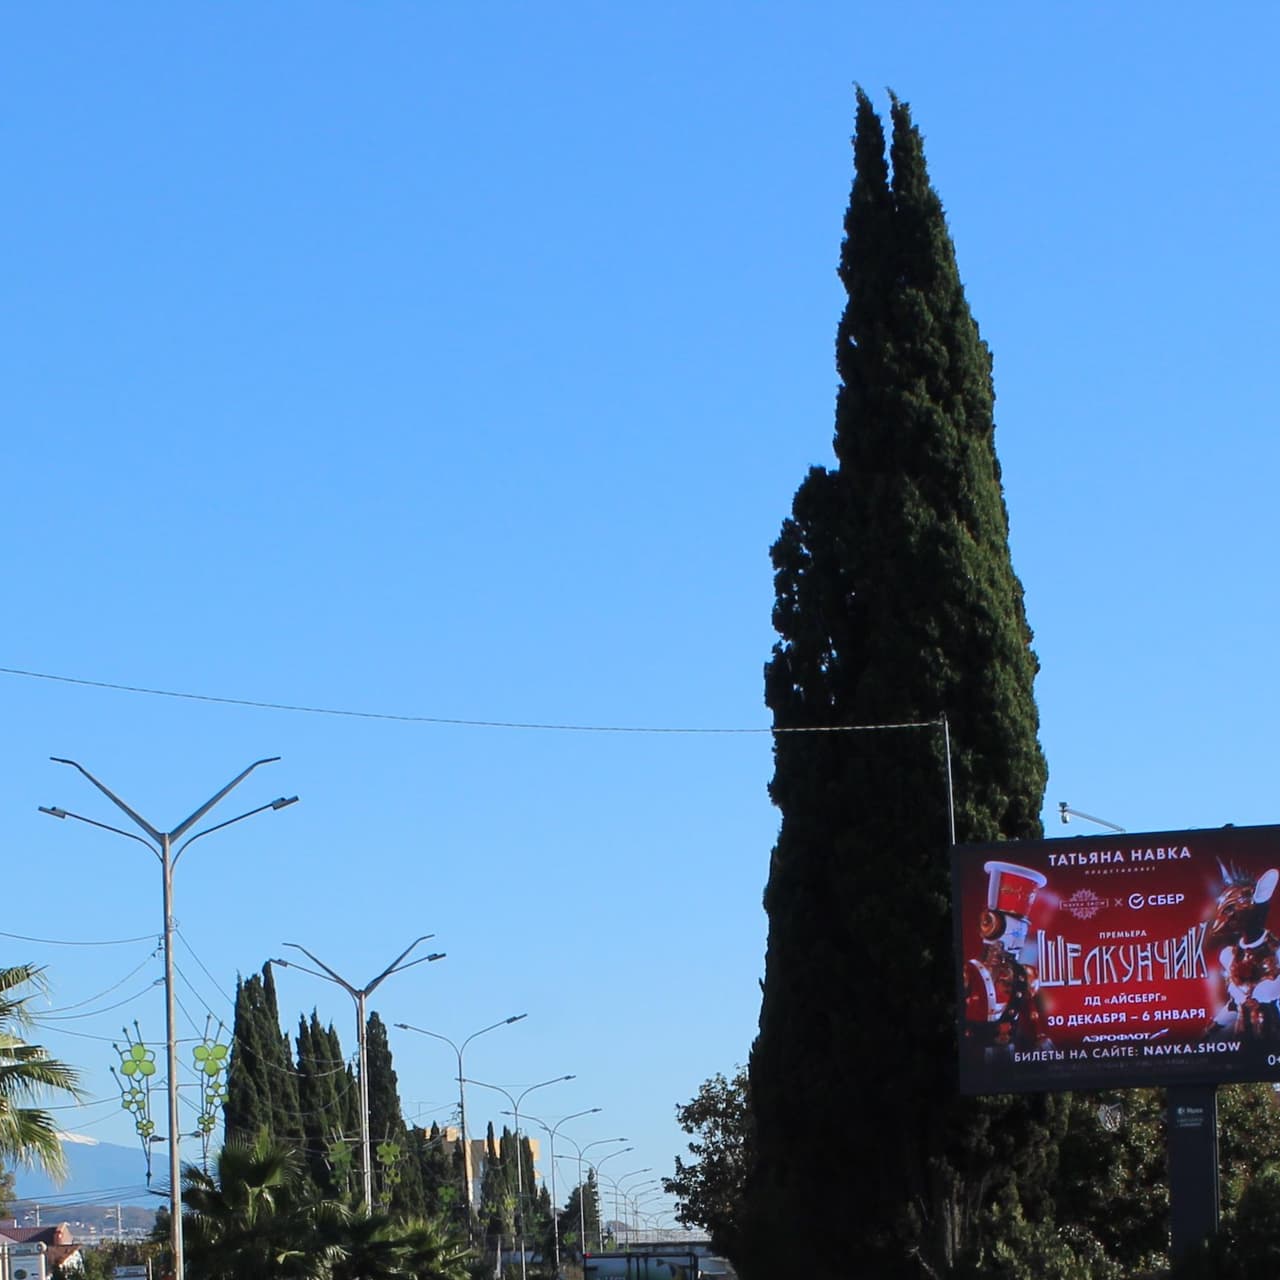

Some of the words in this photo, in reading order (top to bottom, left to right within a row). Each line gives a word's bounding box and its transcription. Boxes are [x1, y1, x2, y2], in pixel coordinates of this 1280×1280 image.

[1048, 850, 1124, 867] ТАТЬЯНА
[1131, 846, 1192, 862] НАВКА
[1147, 893, 1185, 906] СБЕР
[1099, 929, 1148, 940] ПРЕМЬЕРА
[1084, 996, 1102, 1007] ЛД
[1104, 992, 1168, 1005] «АЙСБЕРГ»
[1047, 1014, 1064, 1027] 30
[1067, 1012, 1127, 1028] ДЕКАБРЯ
[1142, 1011, 1151, 1022] 6
[1154, 1008, 1206, 1021] ЯНВАРЯ
[1083, 1032, 1151, 1043] АЭРОФЛОТ
[1014, 1050, 1065, 1063] БИЛЕТЫ
[1070, 1048, 1088, 1060] НА
[1092, 1045, 1140, 1059] САЙТЕ:
[1144, 1041, 1242, 1057] NAVKA.SHOW
